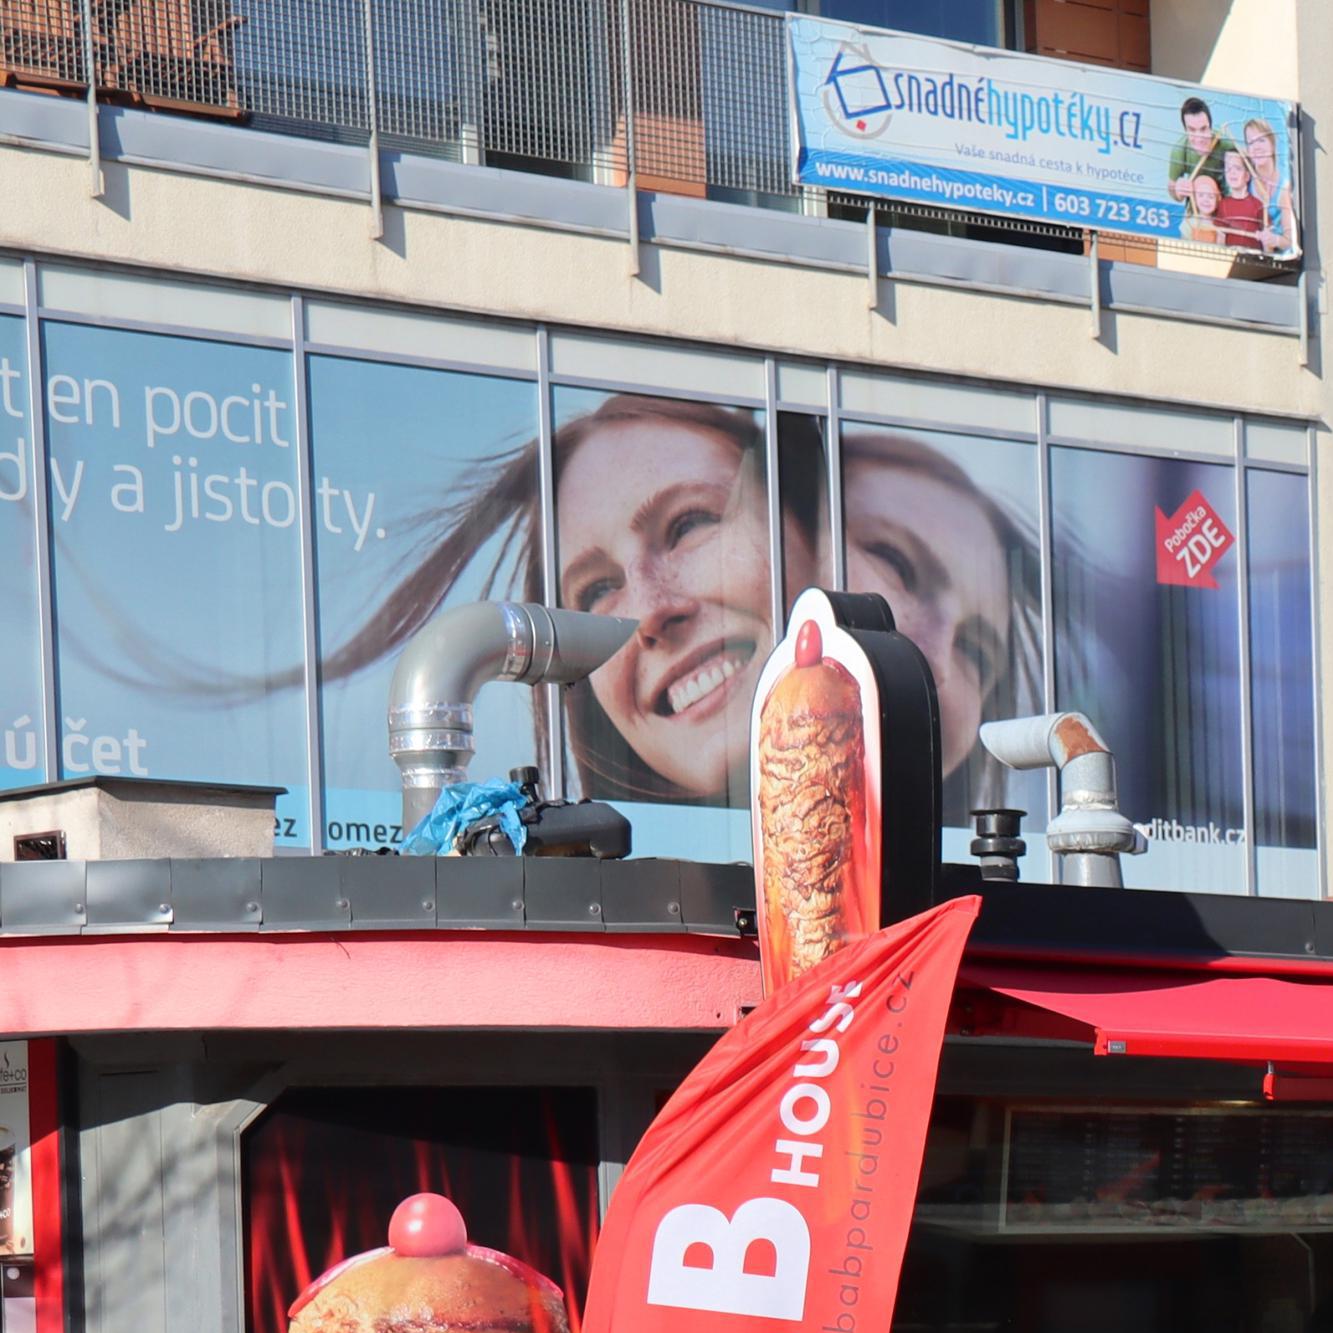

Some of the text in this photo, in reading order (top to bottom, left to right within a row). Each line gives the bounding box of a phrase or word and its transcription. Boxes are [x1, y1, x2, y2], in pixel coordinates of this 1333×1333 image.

[894, 72, 1143, 155] snadnéhypotéky.cz
[815, 160, 1171, 229] www.snadnehypoteky.cz 603 723 263
[954, 143, 1145, 184] Vaše snadná cesta k hypotéce
[144, 382, 290, 448] pocit
[110, 463, 145, 513] a
[164, 453, 387, 552] jistoty.
[1164, 505, 1208, 554] Pobočka
[1175, 517, 1227, 579] ZDE
[5, 714, 149, 776] účet
[769, 978, 863, 1188] HOUSE
